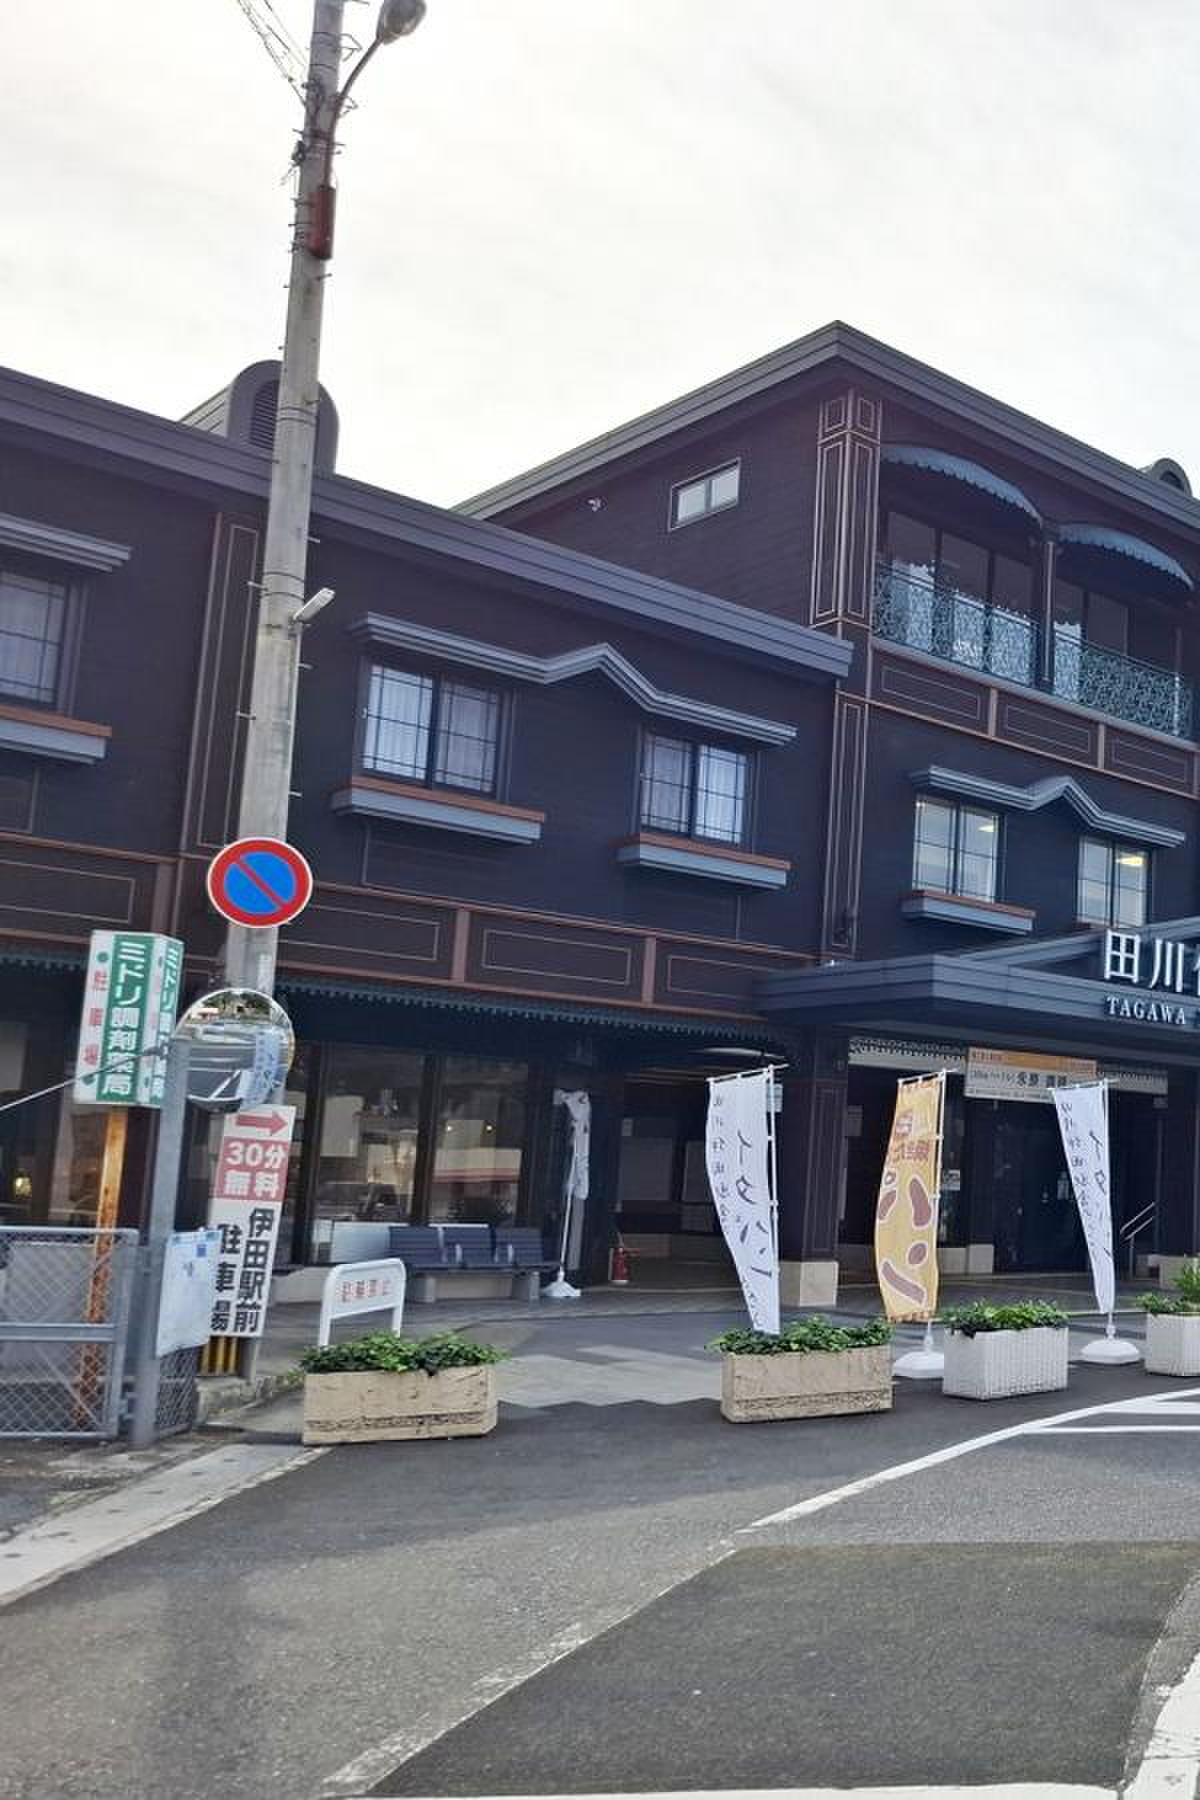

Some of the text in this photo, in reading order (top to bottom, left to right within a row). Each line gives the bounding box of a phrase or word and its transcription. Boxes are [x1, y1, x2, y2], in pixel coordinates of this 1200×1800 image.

[102, 941, 147, 1096] ミドリ調剤薬局
[1107, 996, 1187, 1025] TAGAWA
[226, 1141, 286, 1169] 30分
[223, 1169, 281, 1198] 無料
[234, 1208, 274, 1333] 伊田駅前
